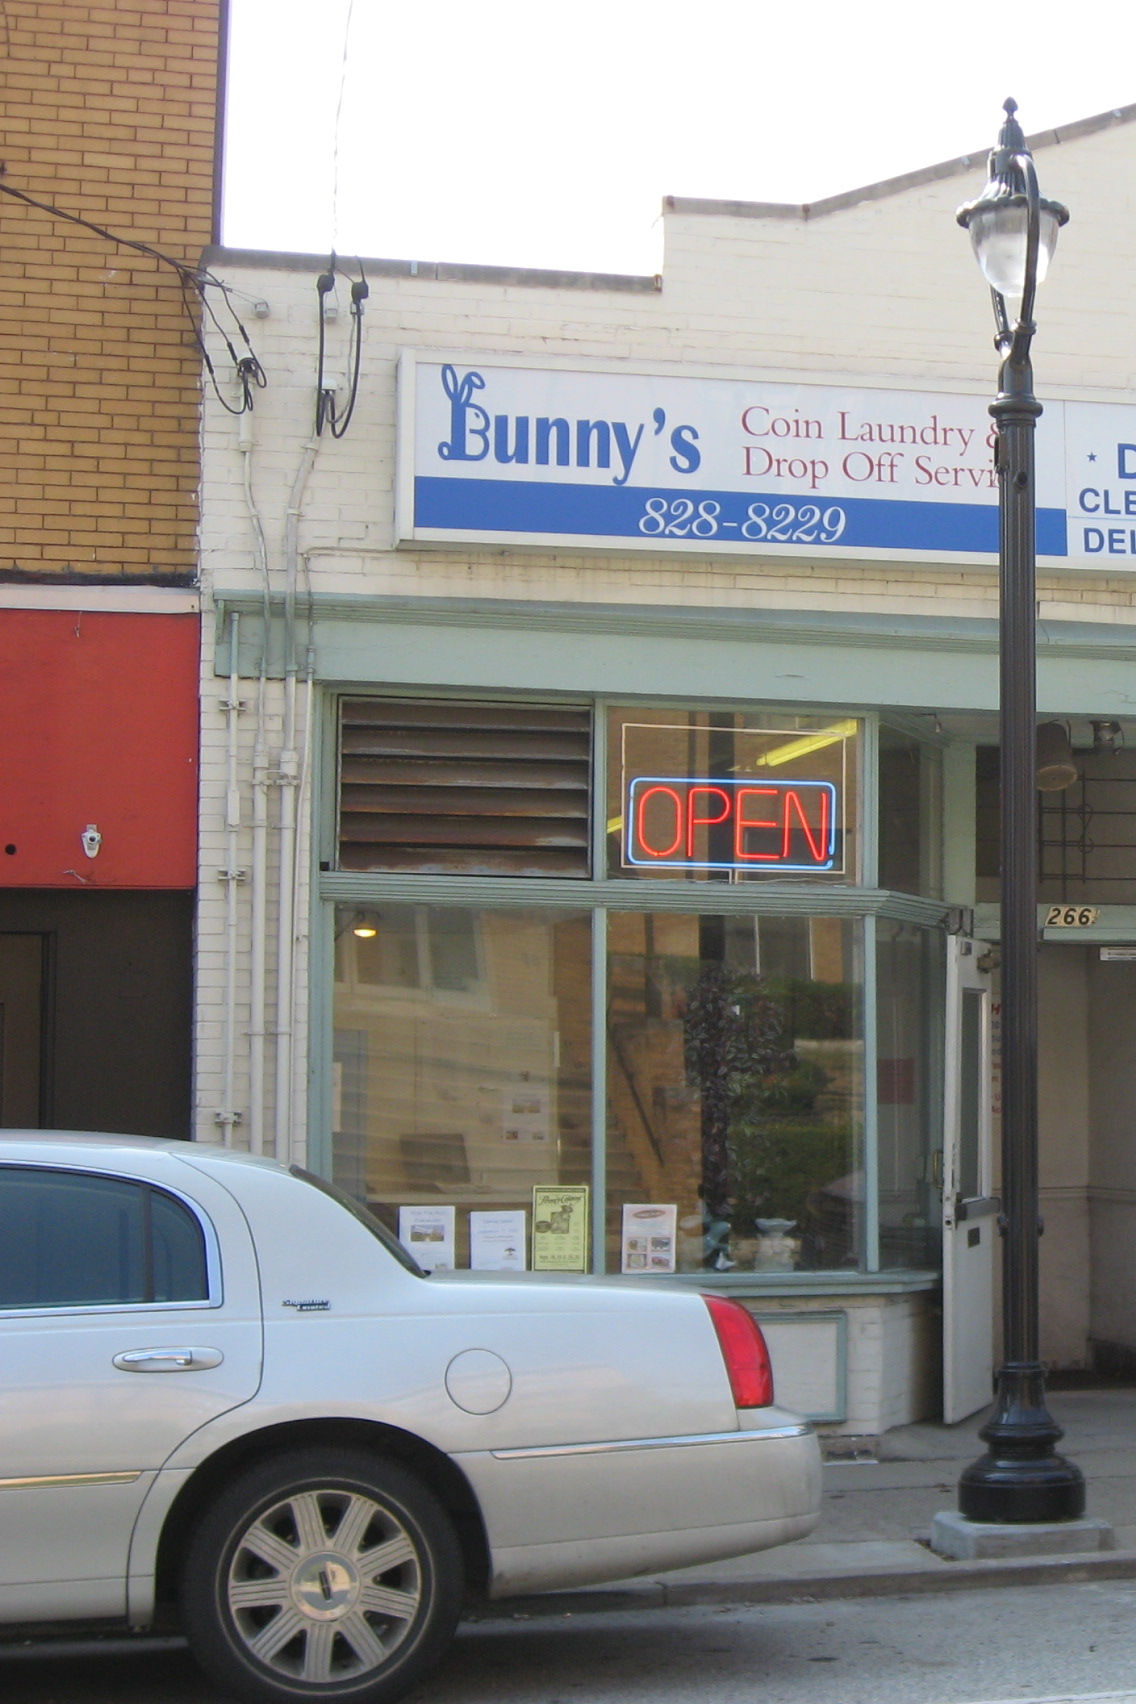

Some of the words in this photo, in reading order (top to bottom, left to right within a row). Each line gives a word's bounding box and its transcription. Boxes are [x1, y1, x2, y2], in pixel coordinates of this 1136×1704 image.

[438, 364, 701, 486] Bunny's
[741, 405, 824, 440] Coin
[838, 410, 975, 456] Laundry
[742, 446, 829, 489] Drop
[841, 450, 905, 484] Off
[914, 455, 999, 488] Servi
[638, 496, 847, 544] 828-8229
[637, 786, 828, 862] OPEN
